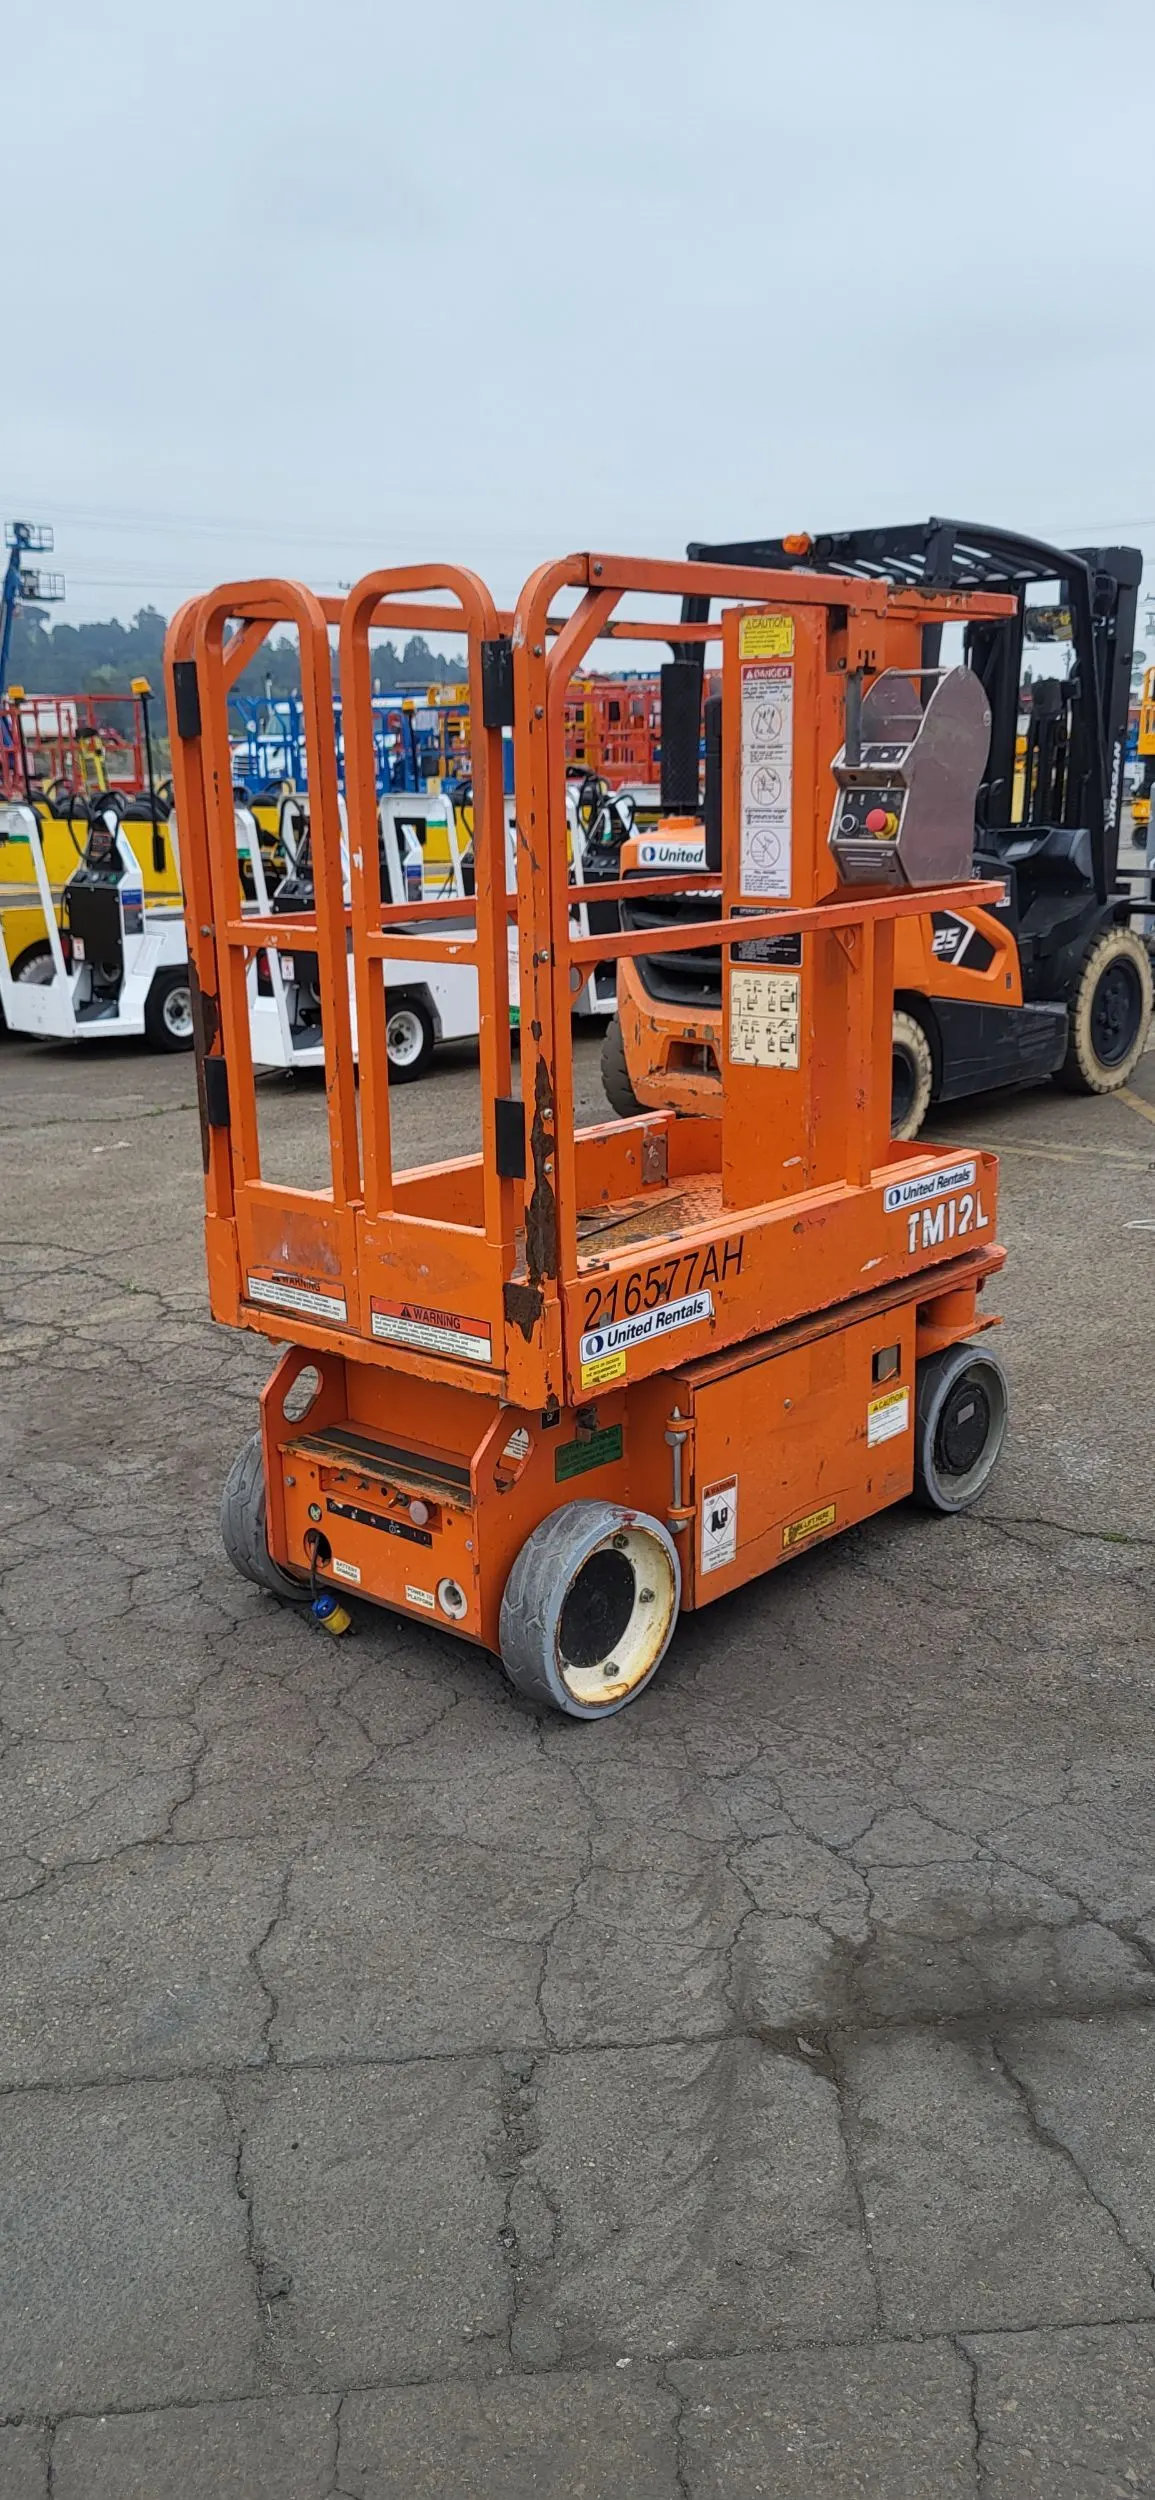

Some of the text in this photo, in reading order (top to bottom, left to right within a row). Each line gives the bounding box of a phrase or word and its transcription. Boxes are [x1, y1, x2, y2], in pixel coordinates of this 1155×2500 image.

[753, 668, 789, 680] DANGER
[1104, 741, 1121, 832] DOOSAN
[658, 846, 704, 863] United
[932, 927, 960, 951] 25
[903, 1168, 971, 1201] United Rentals
[907, 1188, 989, 1254] TM12L
[584, 1235, 744, 1333] 216577AH
[413, 1307, 461, 1330] WARNING
[607, 1299, 704, 1347] United Rentals
[878, 1391, 904, 1410] CAUTION
